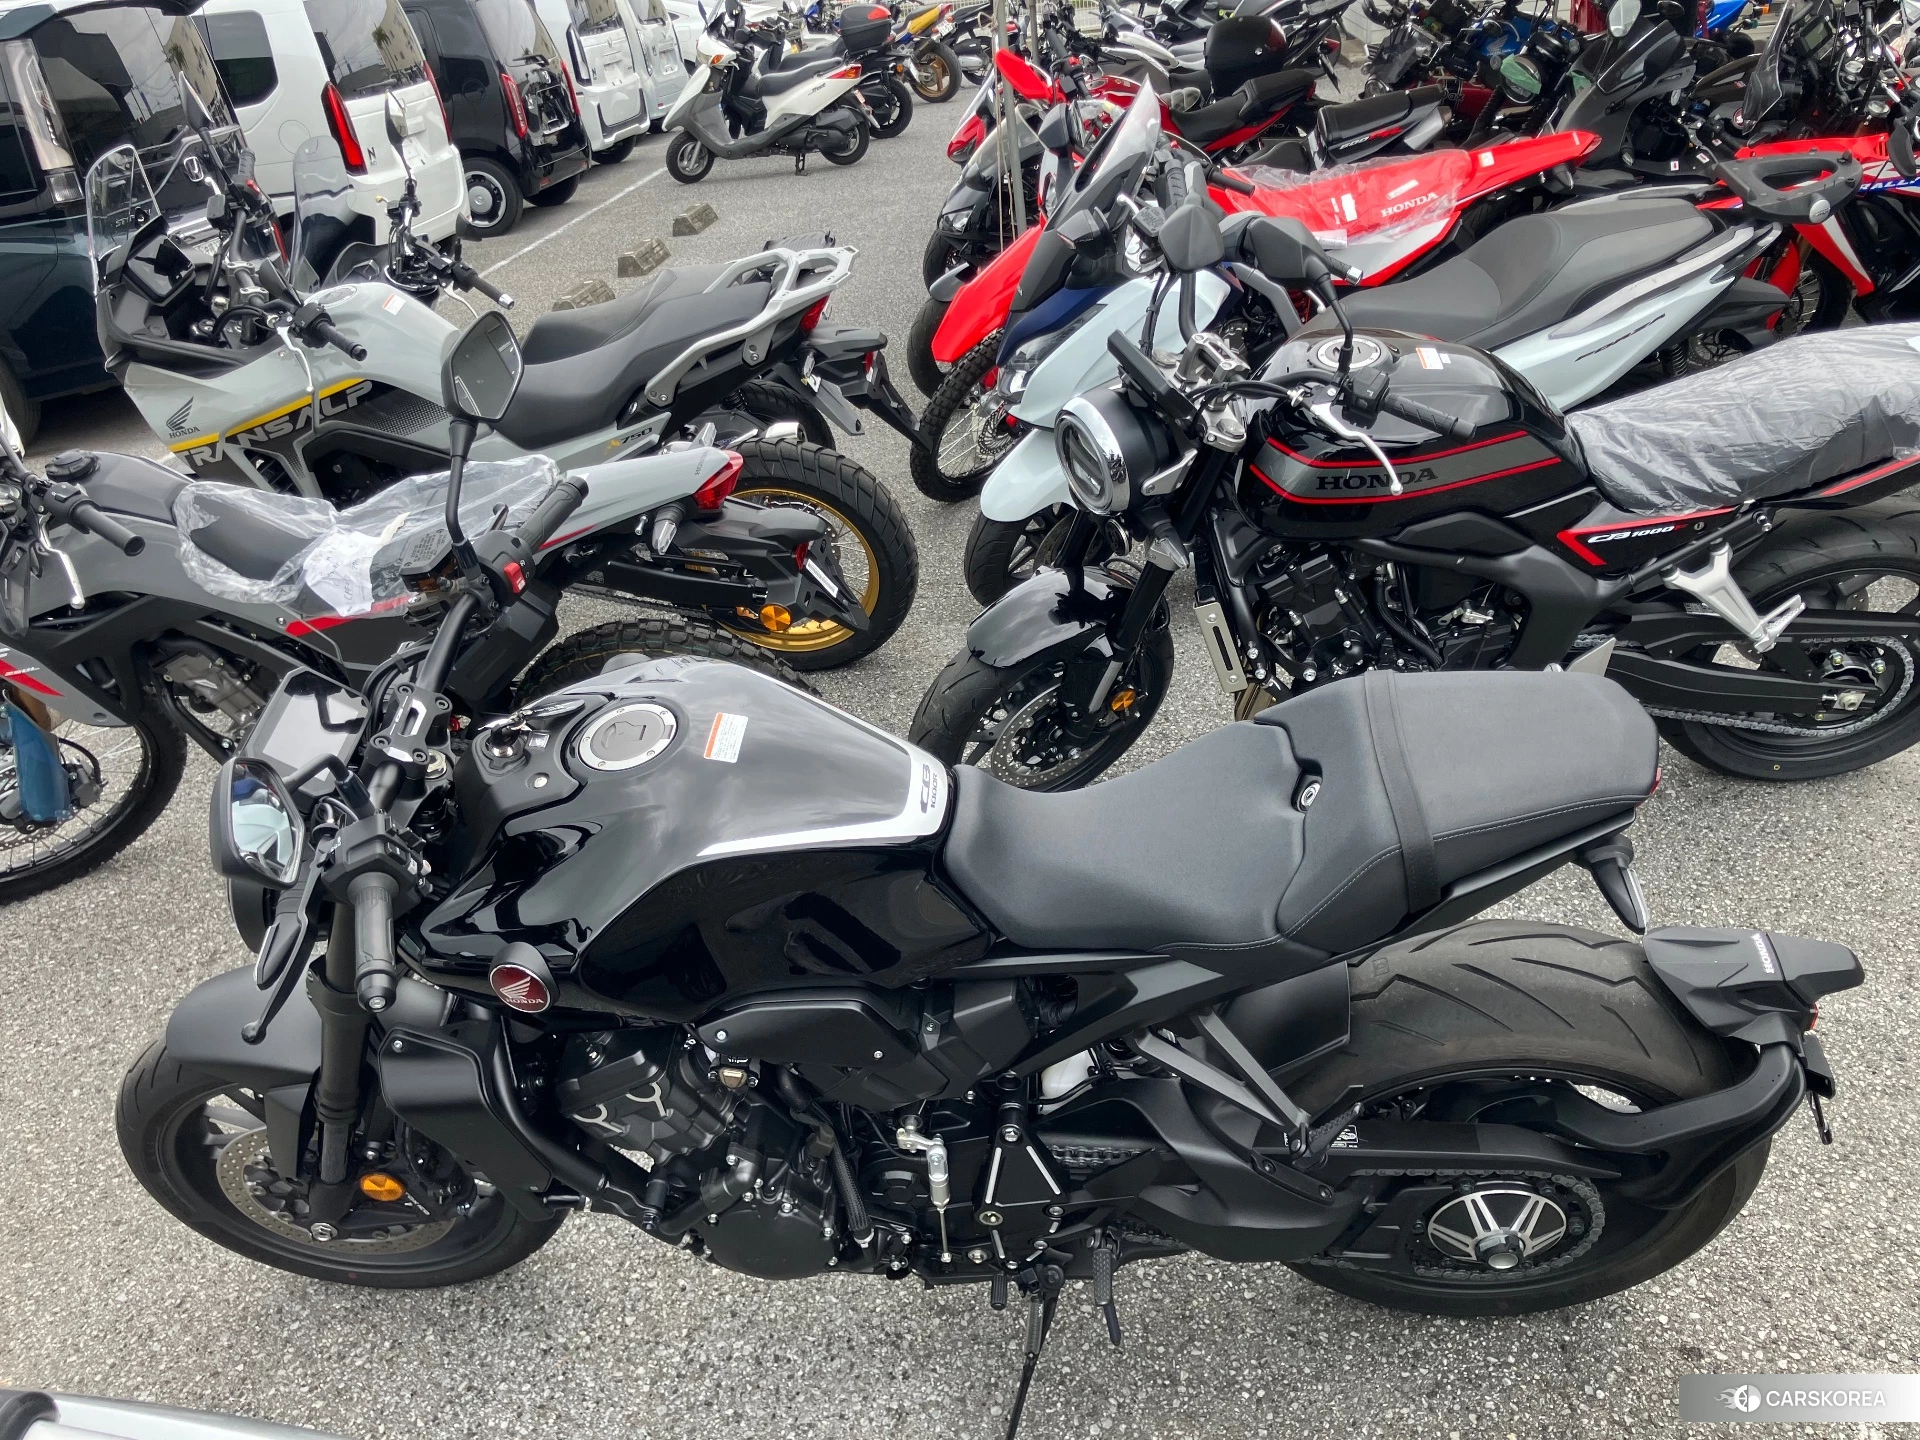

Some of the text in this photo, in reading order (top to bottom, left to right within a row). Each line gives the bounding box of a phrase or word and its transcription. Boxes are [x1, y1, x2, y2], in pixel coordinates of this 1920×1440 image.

[1381, 192, 1439, 217] HONDA
[169, 426, 200, 439] HONDA
[620, 427, 653, 444] 750
[1316, 467, 1438, 490] HONDA
[920, 763, 931, 814] CB
[1751, 933, 1775, 974] HONDA
